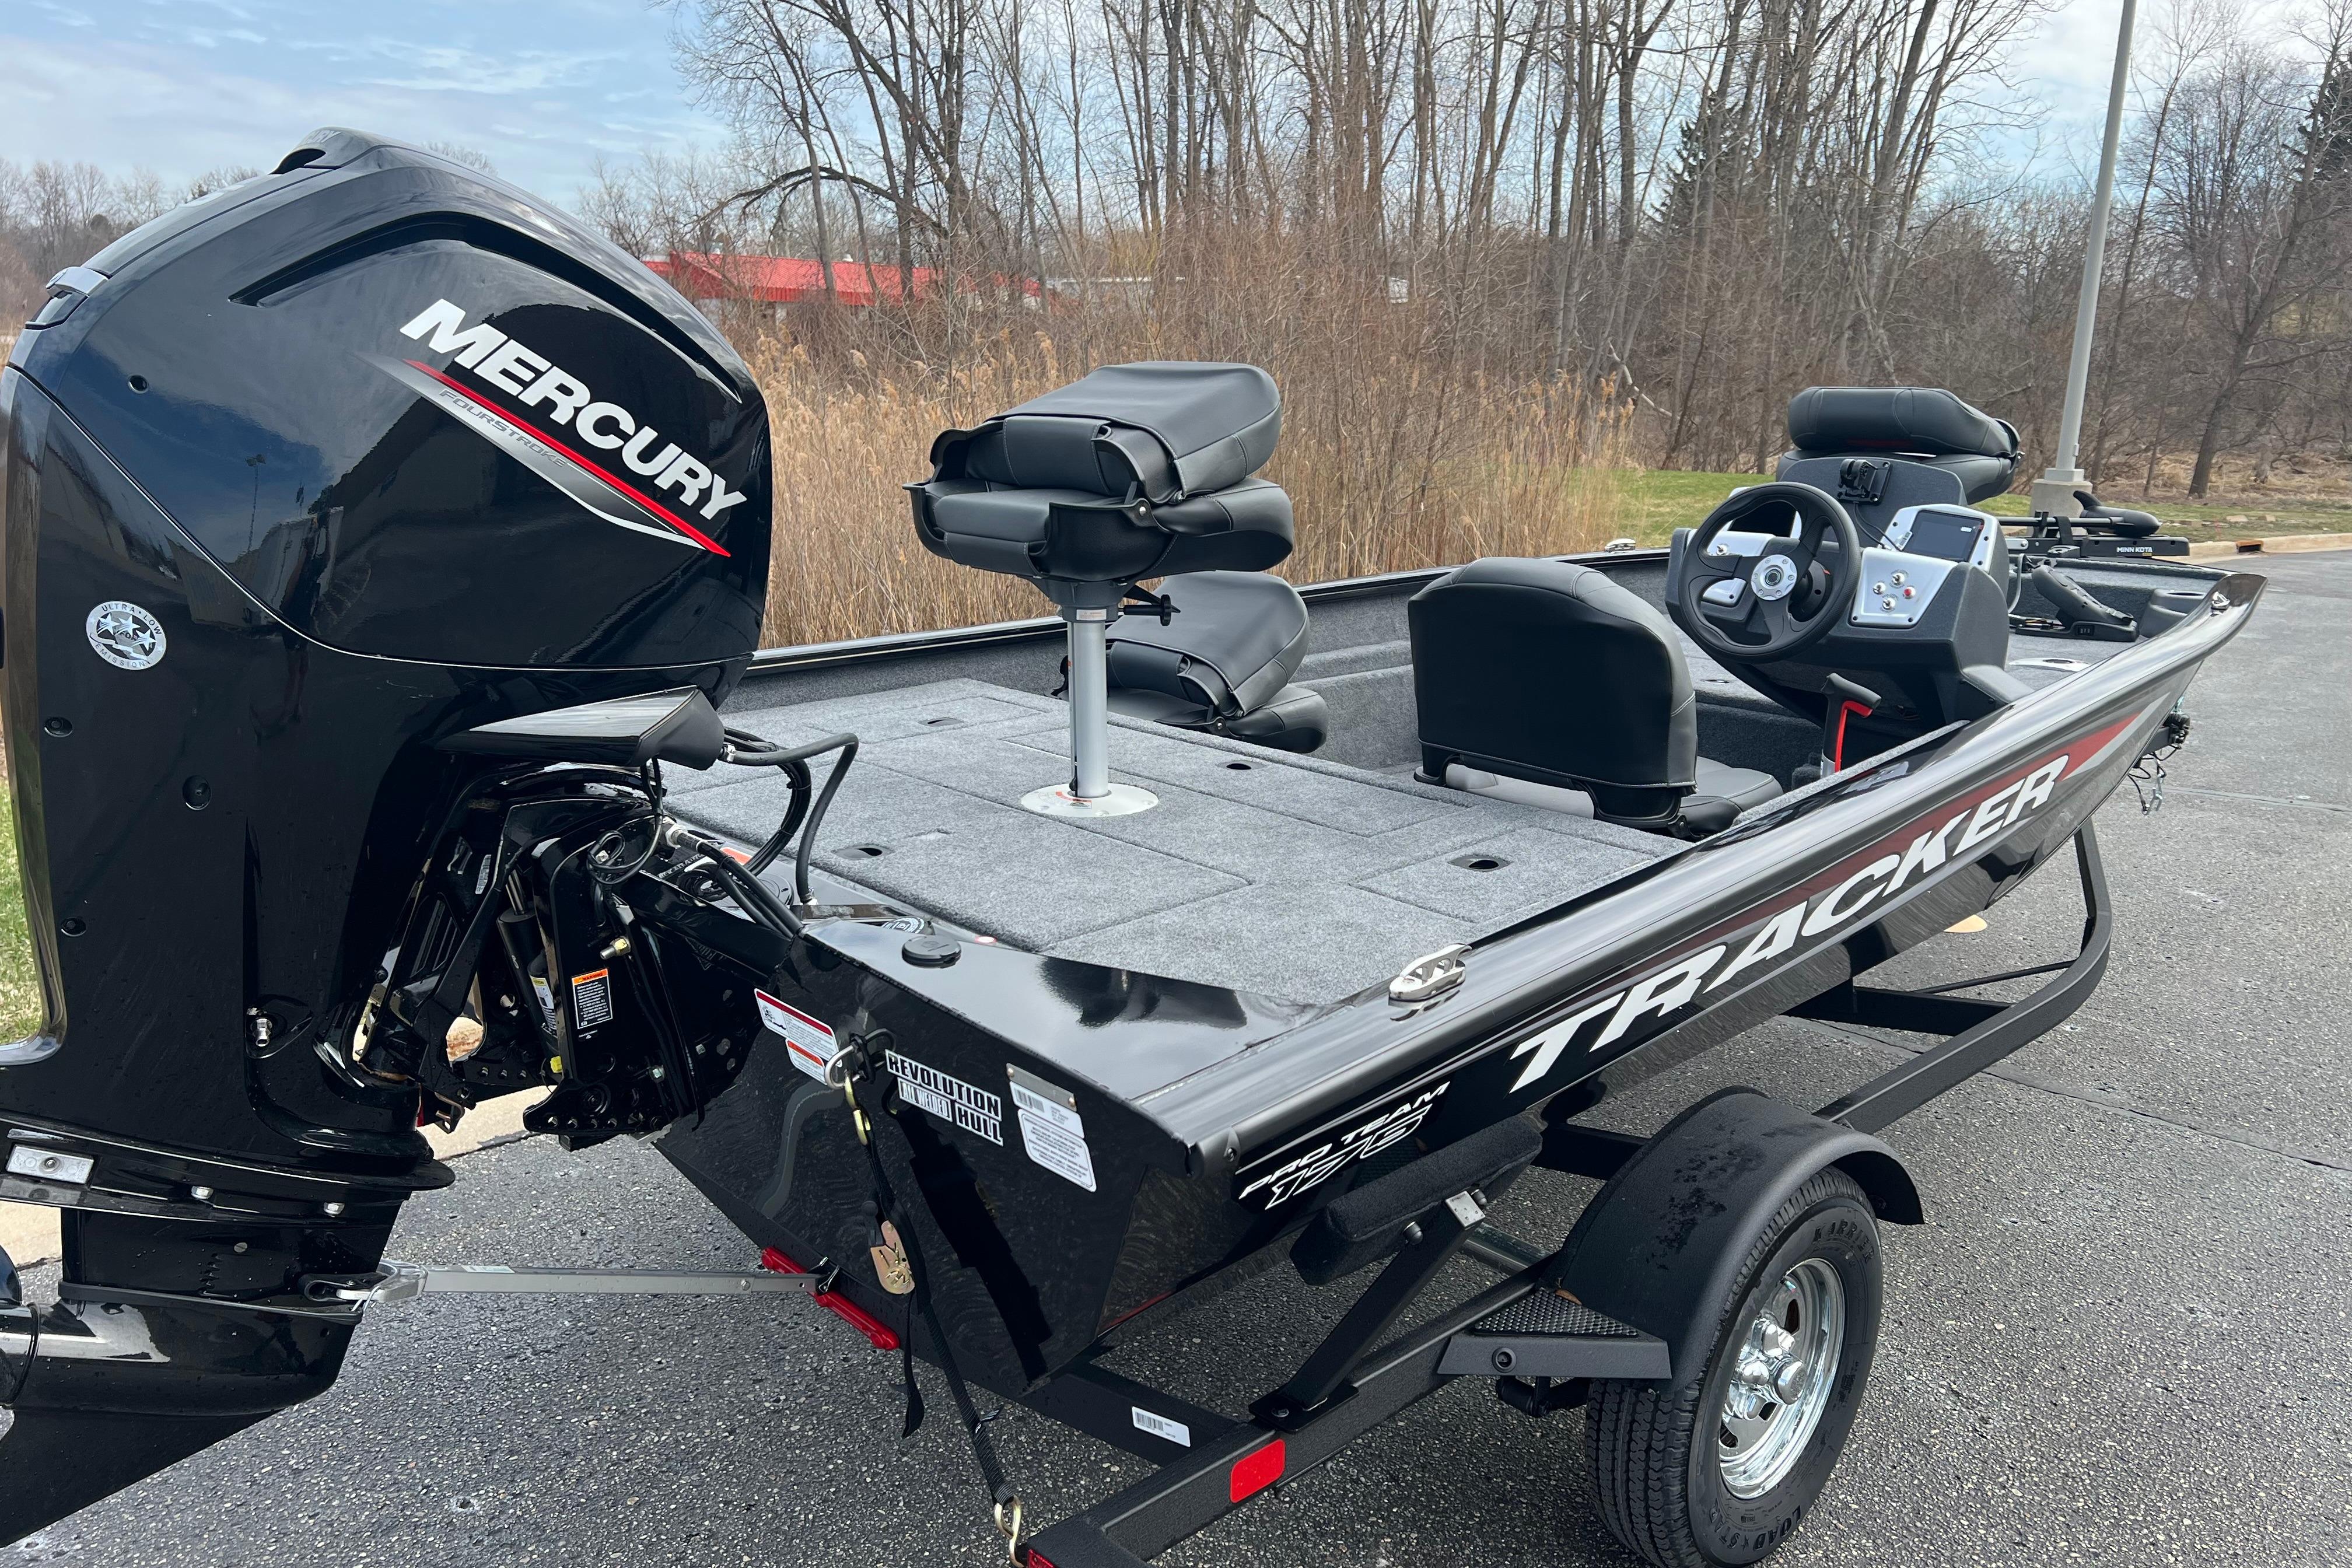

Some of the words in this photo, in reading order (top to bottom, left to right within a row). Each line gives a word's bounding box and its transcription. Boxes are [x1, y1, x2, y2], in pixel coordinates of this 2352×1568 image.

[400, 298, 747, 520] MERCURY
[439, 388, 568, 467] FOURSTROKE
[101, 603, 135, 614] ULTRA
[142, 614, 163, 635] LOW
[94, 643, 146, 668] EMISSION
[1509, 754, 2069, 1094] TRACKER
[887, 1053, 1000, 1118] REVOLUTION
[901, 1083, 917, 1102] ALL
[915, 1088, 950, 1117] WELDED
[957, 1105, 1003, 1144] HULL
[1238, 1143, 1333, 1200] PRO
[1340, 1080, 1451, 1144] TEAM
[1265, 1103, 1433, 1210] 175
[1812, 1219, 1875, 1264] KARRIER
